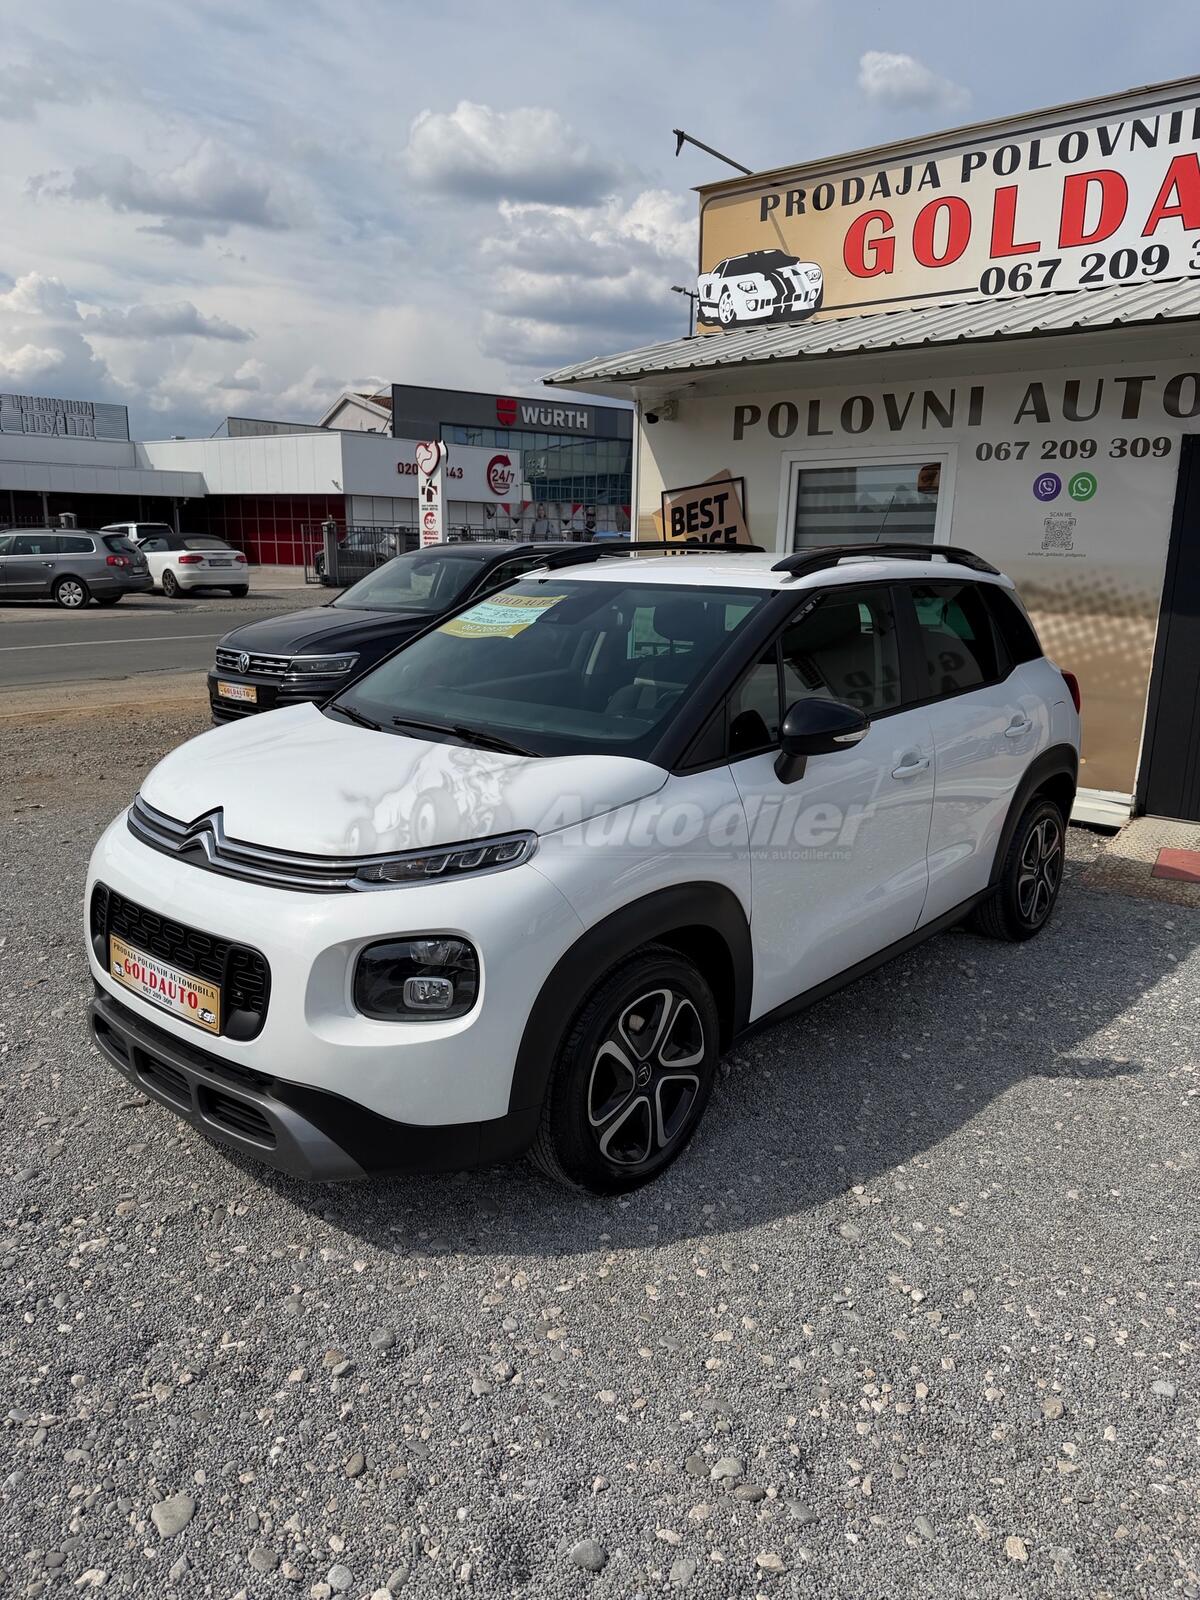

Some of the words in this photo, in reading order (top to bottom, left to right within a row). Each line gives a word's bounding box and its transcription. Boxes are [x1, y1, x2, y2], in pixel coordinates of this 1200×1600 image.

[760, 161, 941, 221] PRODAJA
[843, 152, 1200, 278] GOLDA
[978, 258, 1062, 296] 067
[1078, 244, 1170, 284] 209
[733, 386, 985, 441] POLOVNI
[1013, 372, 1200, 424] AUTO
[491, 468, 515, 483] 24/7
[975, 441, 1031, 462] 067
[1040, 439, 1098, 460] 209
[1108, 437, 1172, 458] 309
[671, 492, 729, 538] BEST
[113, 942, 137, 961] PRODAJA
[169, 971, 215, 999] AUTOMOBILA
[124, 958, 198, 1010] GOLDAUTO
